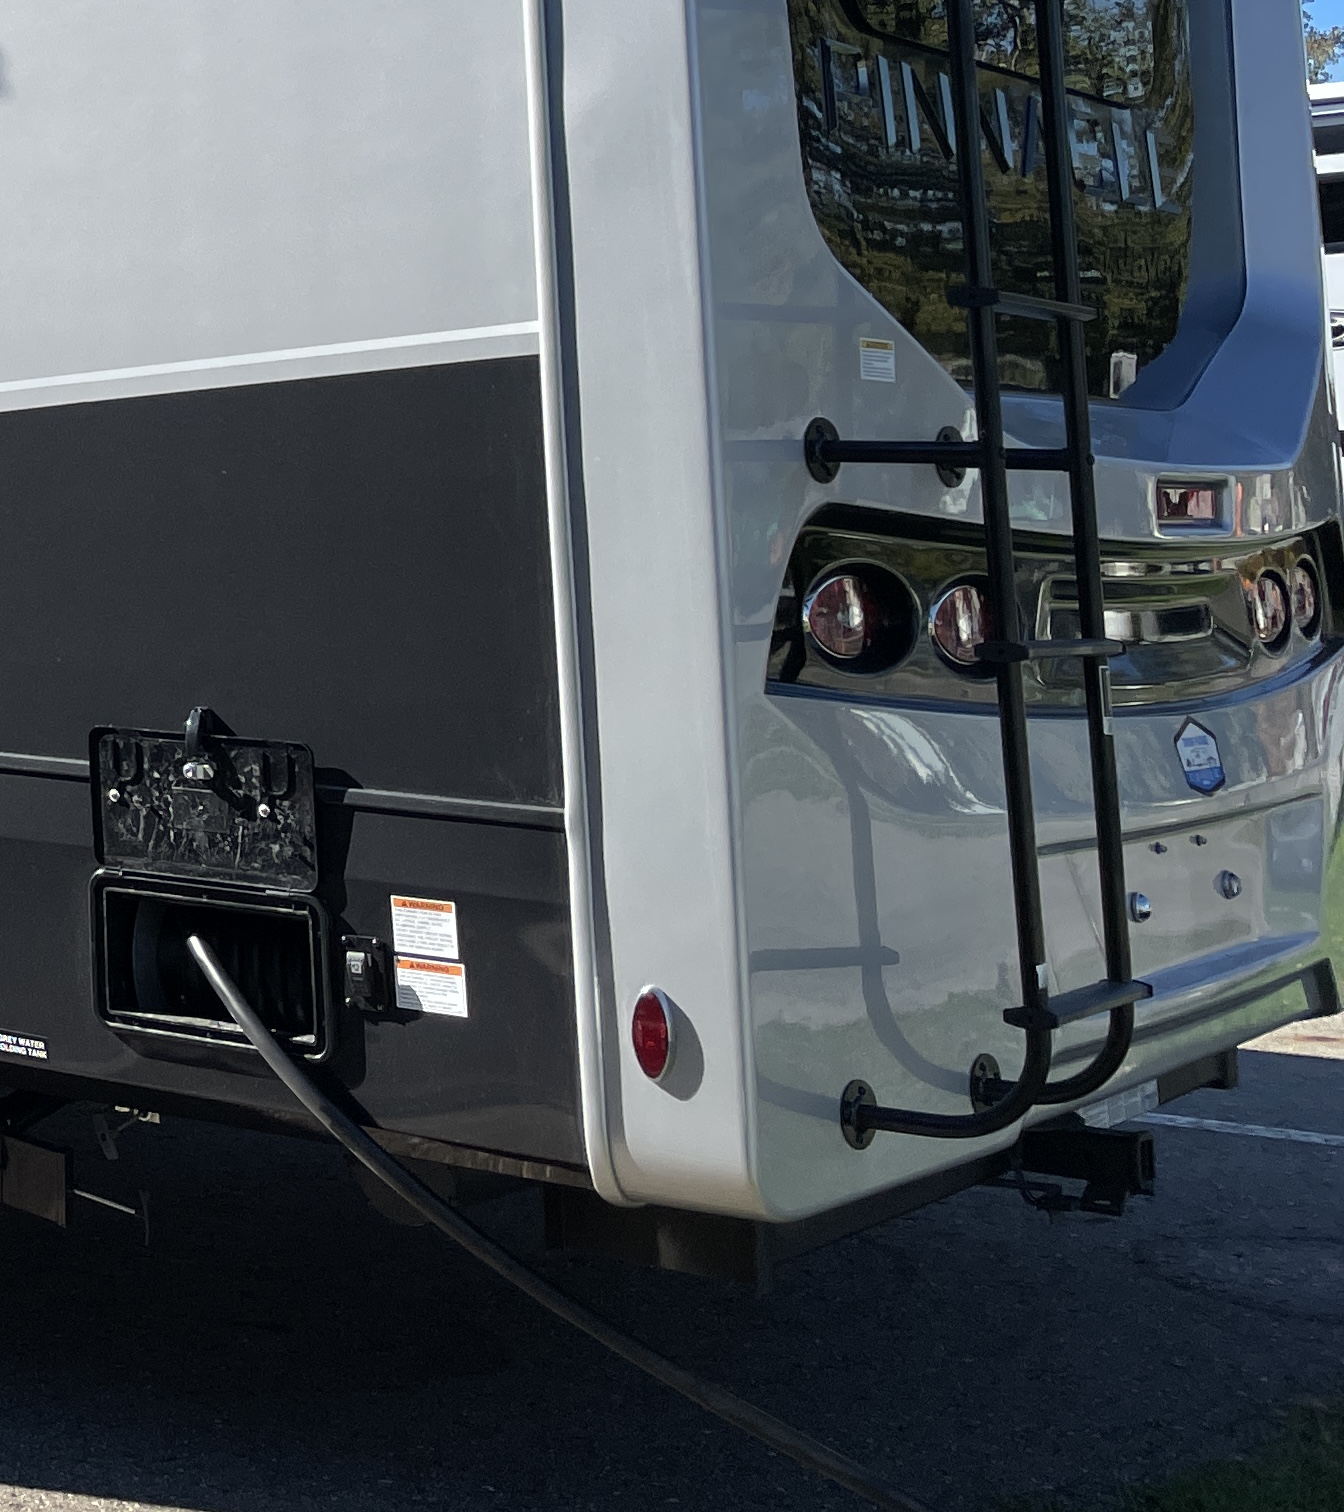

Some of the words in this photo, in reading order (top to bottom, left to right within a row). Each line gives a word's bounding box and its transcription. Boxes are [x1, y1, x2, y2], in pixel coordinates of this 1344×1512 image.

[409, 901, 445, 911] WARNING
[416, 963, 450, 974] WARNING
[18, 1037, 45, 1049] WATER
[27, 1047, 48, 1059] TANK
